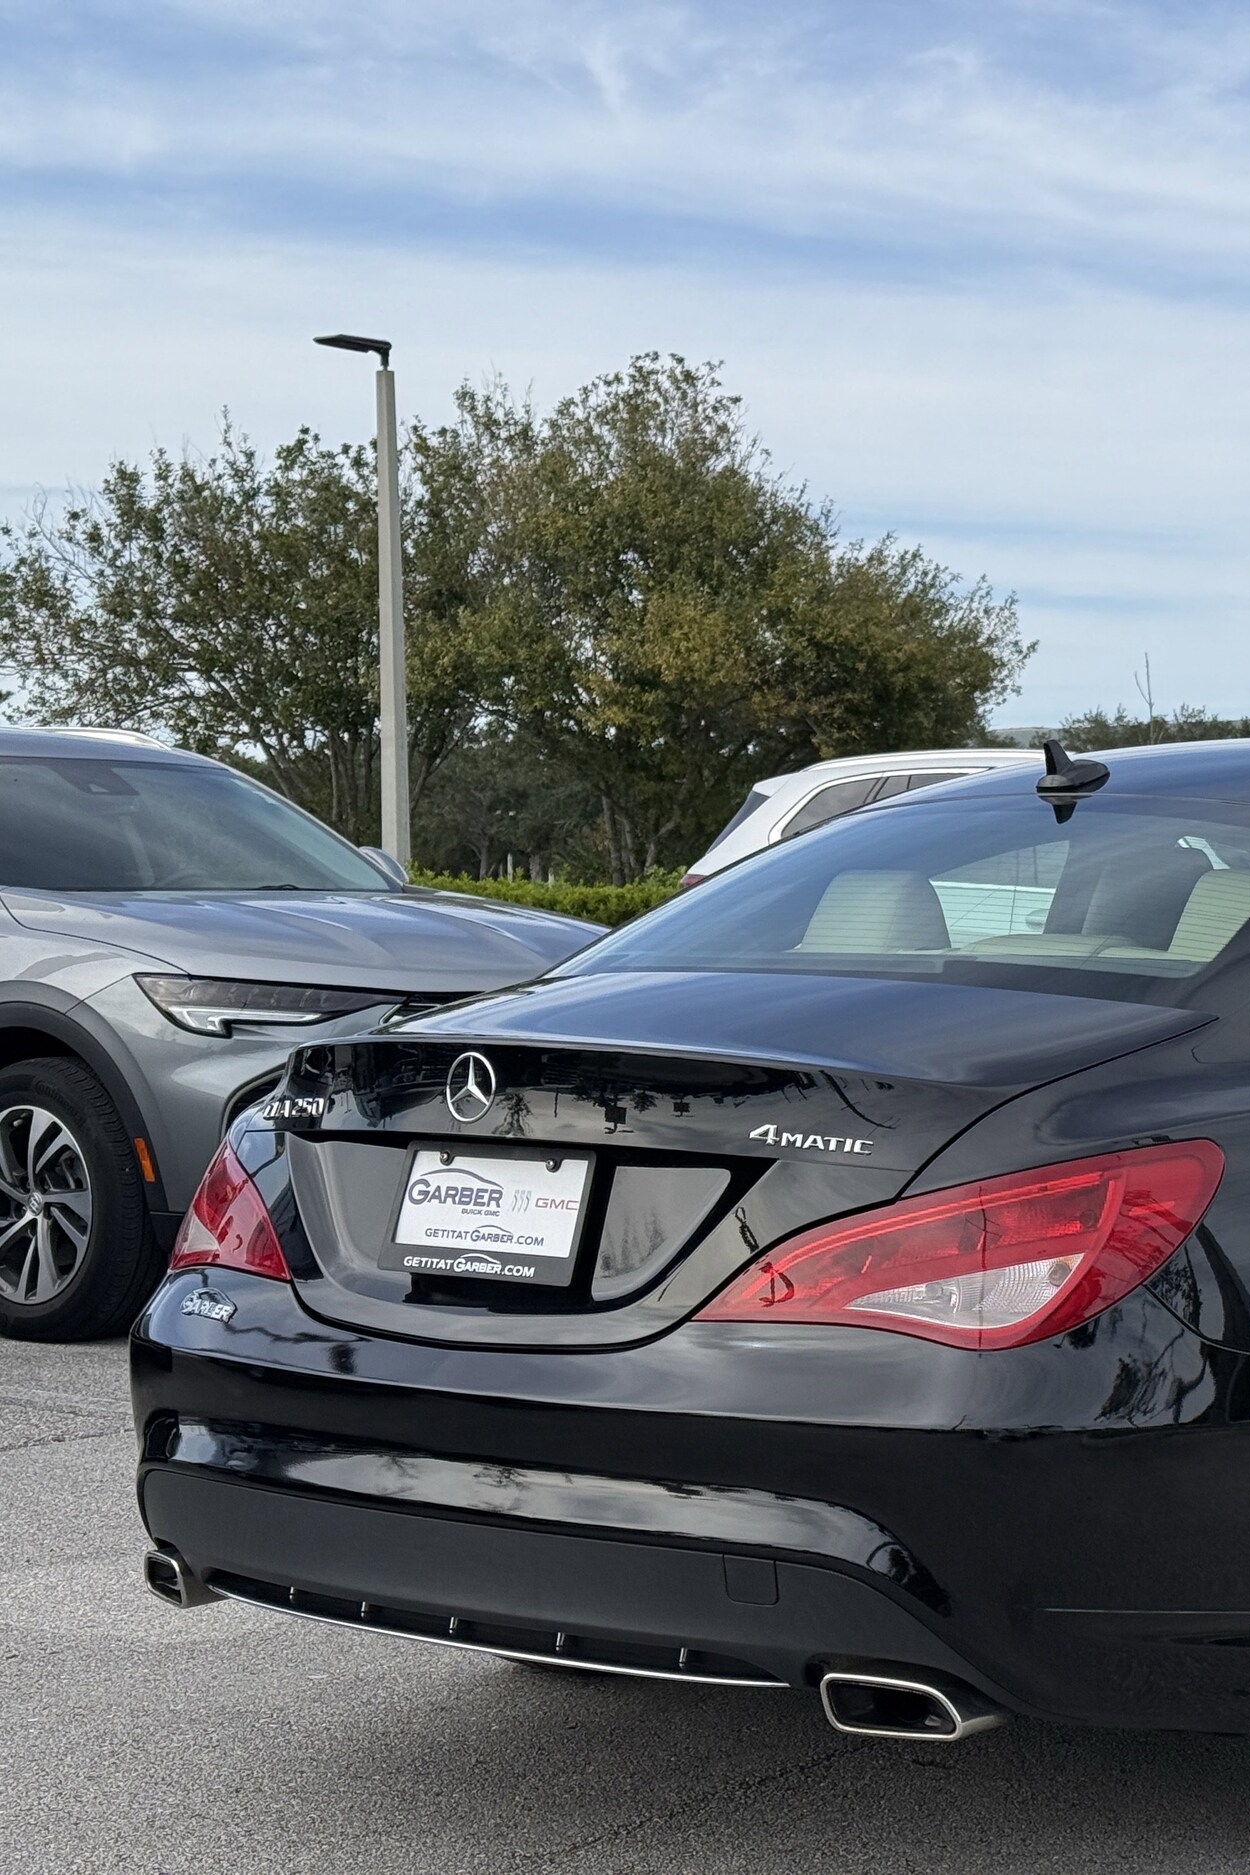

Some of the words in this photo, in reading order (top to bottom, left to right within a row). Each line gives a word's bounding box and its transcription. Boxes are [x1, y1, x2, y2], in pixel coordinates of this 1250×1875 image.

[749, 1123, 874, 1155] 4MATIC
[407, 1177, 504, 1209] GARBER
[534, 1197, 580, 1211] GMC
[461, 1208, 483, 1216] BUICK
[484, 1209, 501, 1217] GMC
